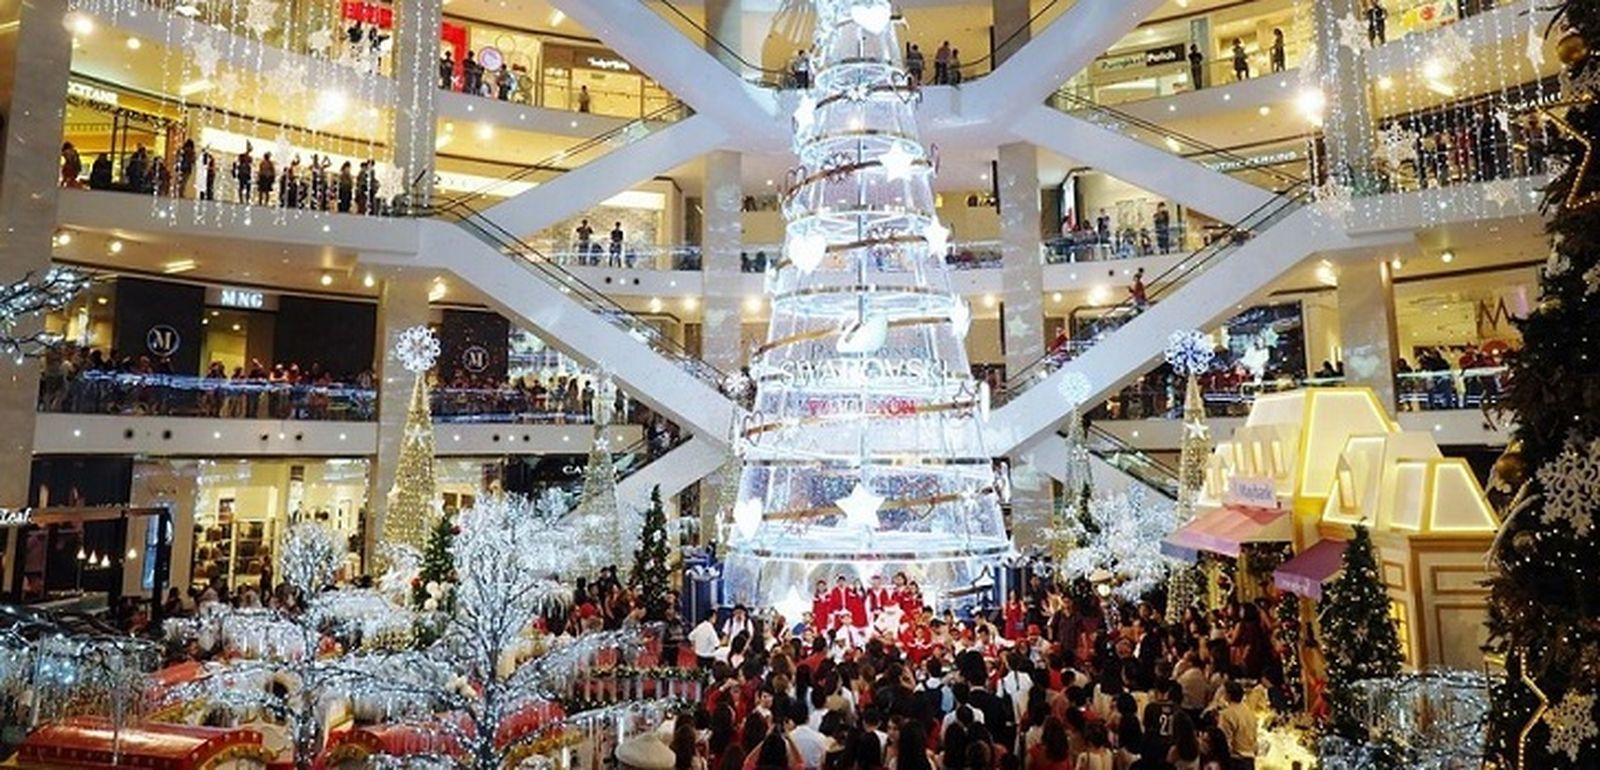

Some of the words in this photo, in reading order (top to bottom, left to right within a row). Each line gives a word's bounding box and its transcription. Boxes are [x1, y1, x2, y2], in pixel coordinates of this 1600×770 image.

[222, 290, 263, 308] MNG
[780, 358, 948, 387] SWAROVSKI
[1159, 714, 1174, 737] 21
